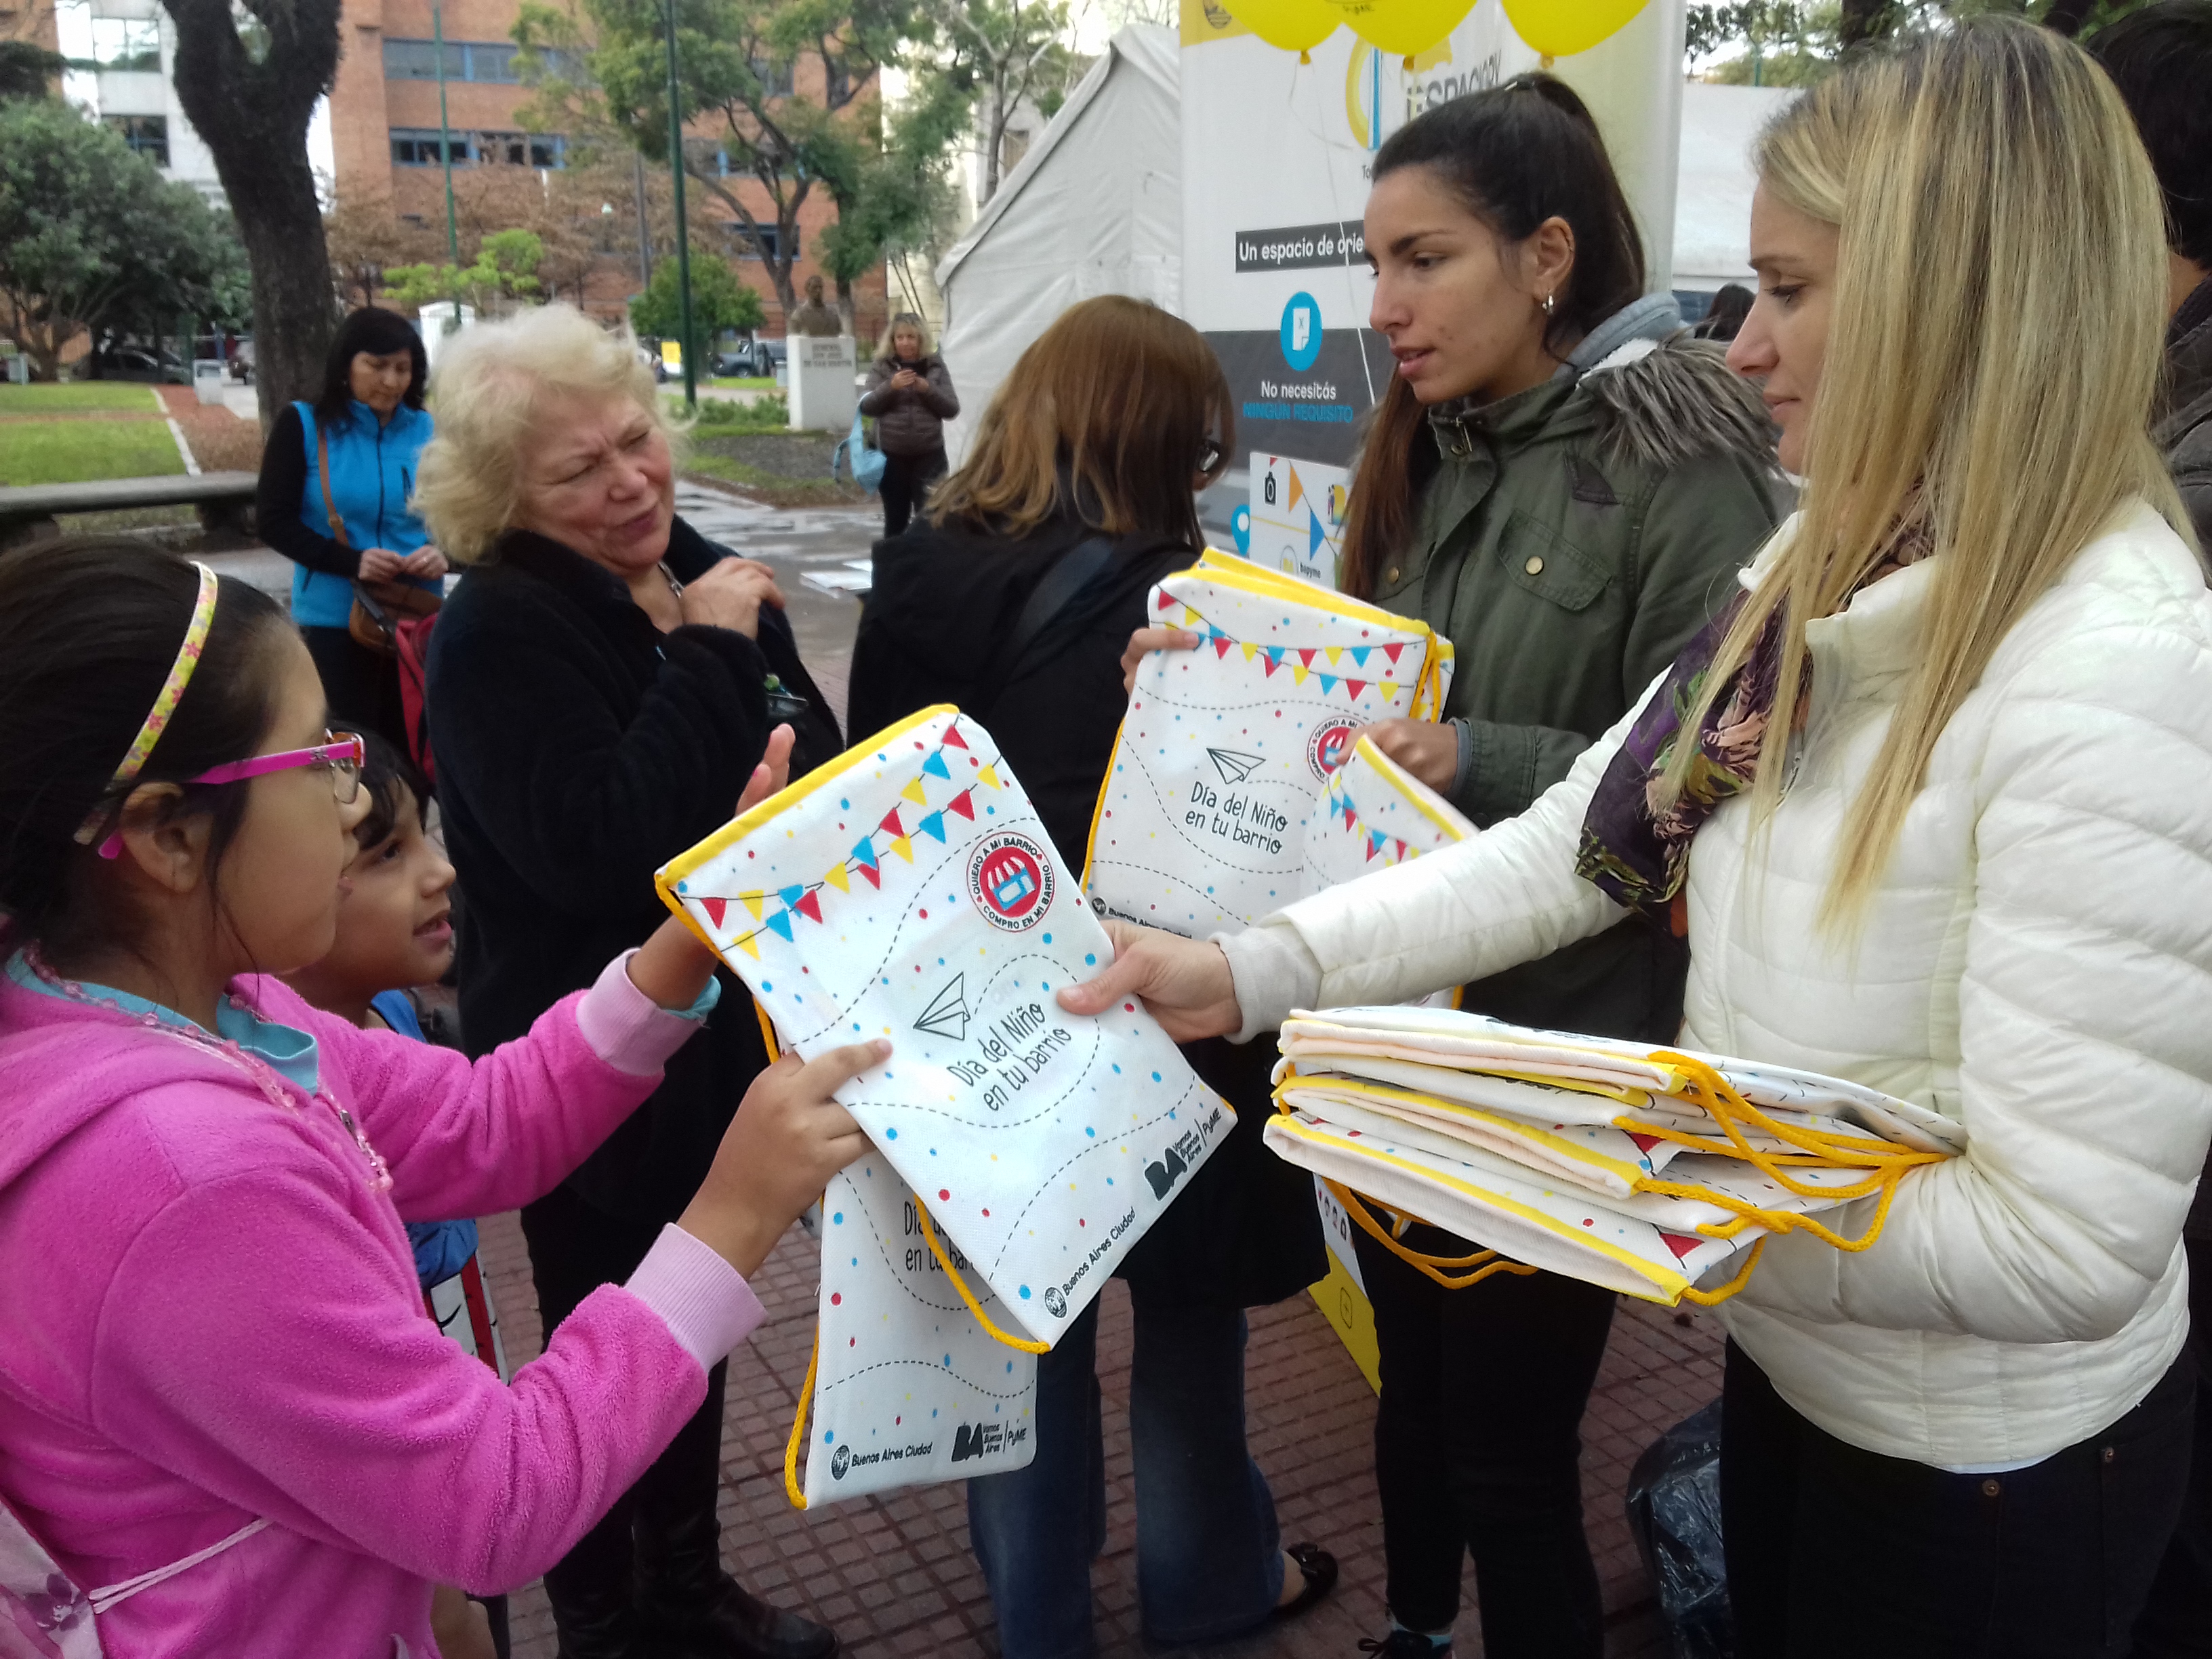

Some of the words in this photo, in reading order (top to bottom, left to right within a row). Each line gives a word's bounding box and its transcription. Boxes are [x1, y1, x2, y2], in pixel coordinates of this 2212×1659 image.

[1240, 241, 1257, 262] Un
[1262, 237, 1313, 265] espacio
[1317, 232, 1334, 256] de
[1261, 380, 1277, 398] No
[1281, 380, 1337, 400] necesitás
[1191, 781, 1217, 808] Día
[1223, 792, 1248, 819] del
[1250, 800, 1288, 832] Niño
[1185, 811, 1206, 829] en
[1212, 813, 1229, 837] tu
[1233, 819, 1282, 855] barrio
[972, 855, 983, 895] QUIERO
[983, 848, 990, 857] A
[989, 840, 1002, 851] MI
[1003, 837, 1038, 856] BARRIO
[983, 905, 1020, 929] COMPRO
[1022, 916, 1034, 928] EN
[1033, 905, 1044, 918] MI
[1042, 865, 1052, 905] BARRIO
[946, 1061, 989, 1087] Día
[977, 1025, 1013, 1063] del
[1000, 1003, 1046, 1044] Niño
[1012, 1028, 1071, 1074] barrio
[983, 1084, 1009, 1111] en
[996, 1065, 1029, 1091] tu
[905, 1248, 922, 1271] en
[1061, 1262, 1090, 1296] Buenos
[1088, 1237, 1112, 1265] Aires
[1109, 1206, 1136, 1241] Ciudad
[851, 1452, 880, 1467] Buenos
[881, 1447, 904, 1462] Aires
[905, 1441, 933, 1458] Ciudad
